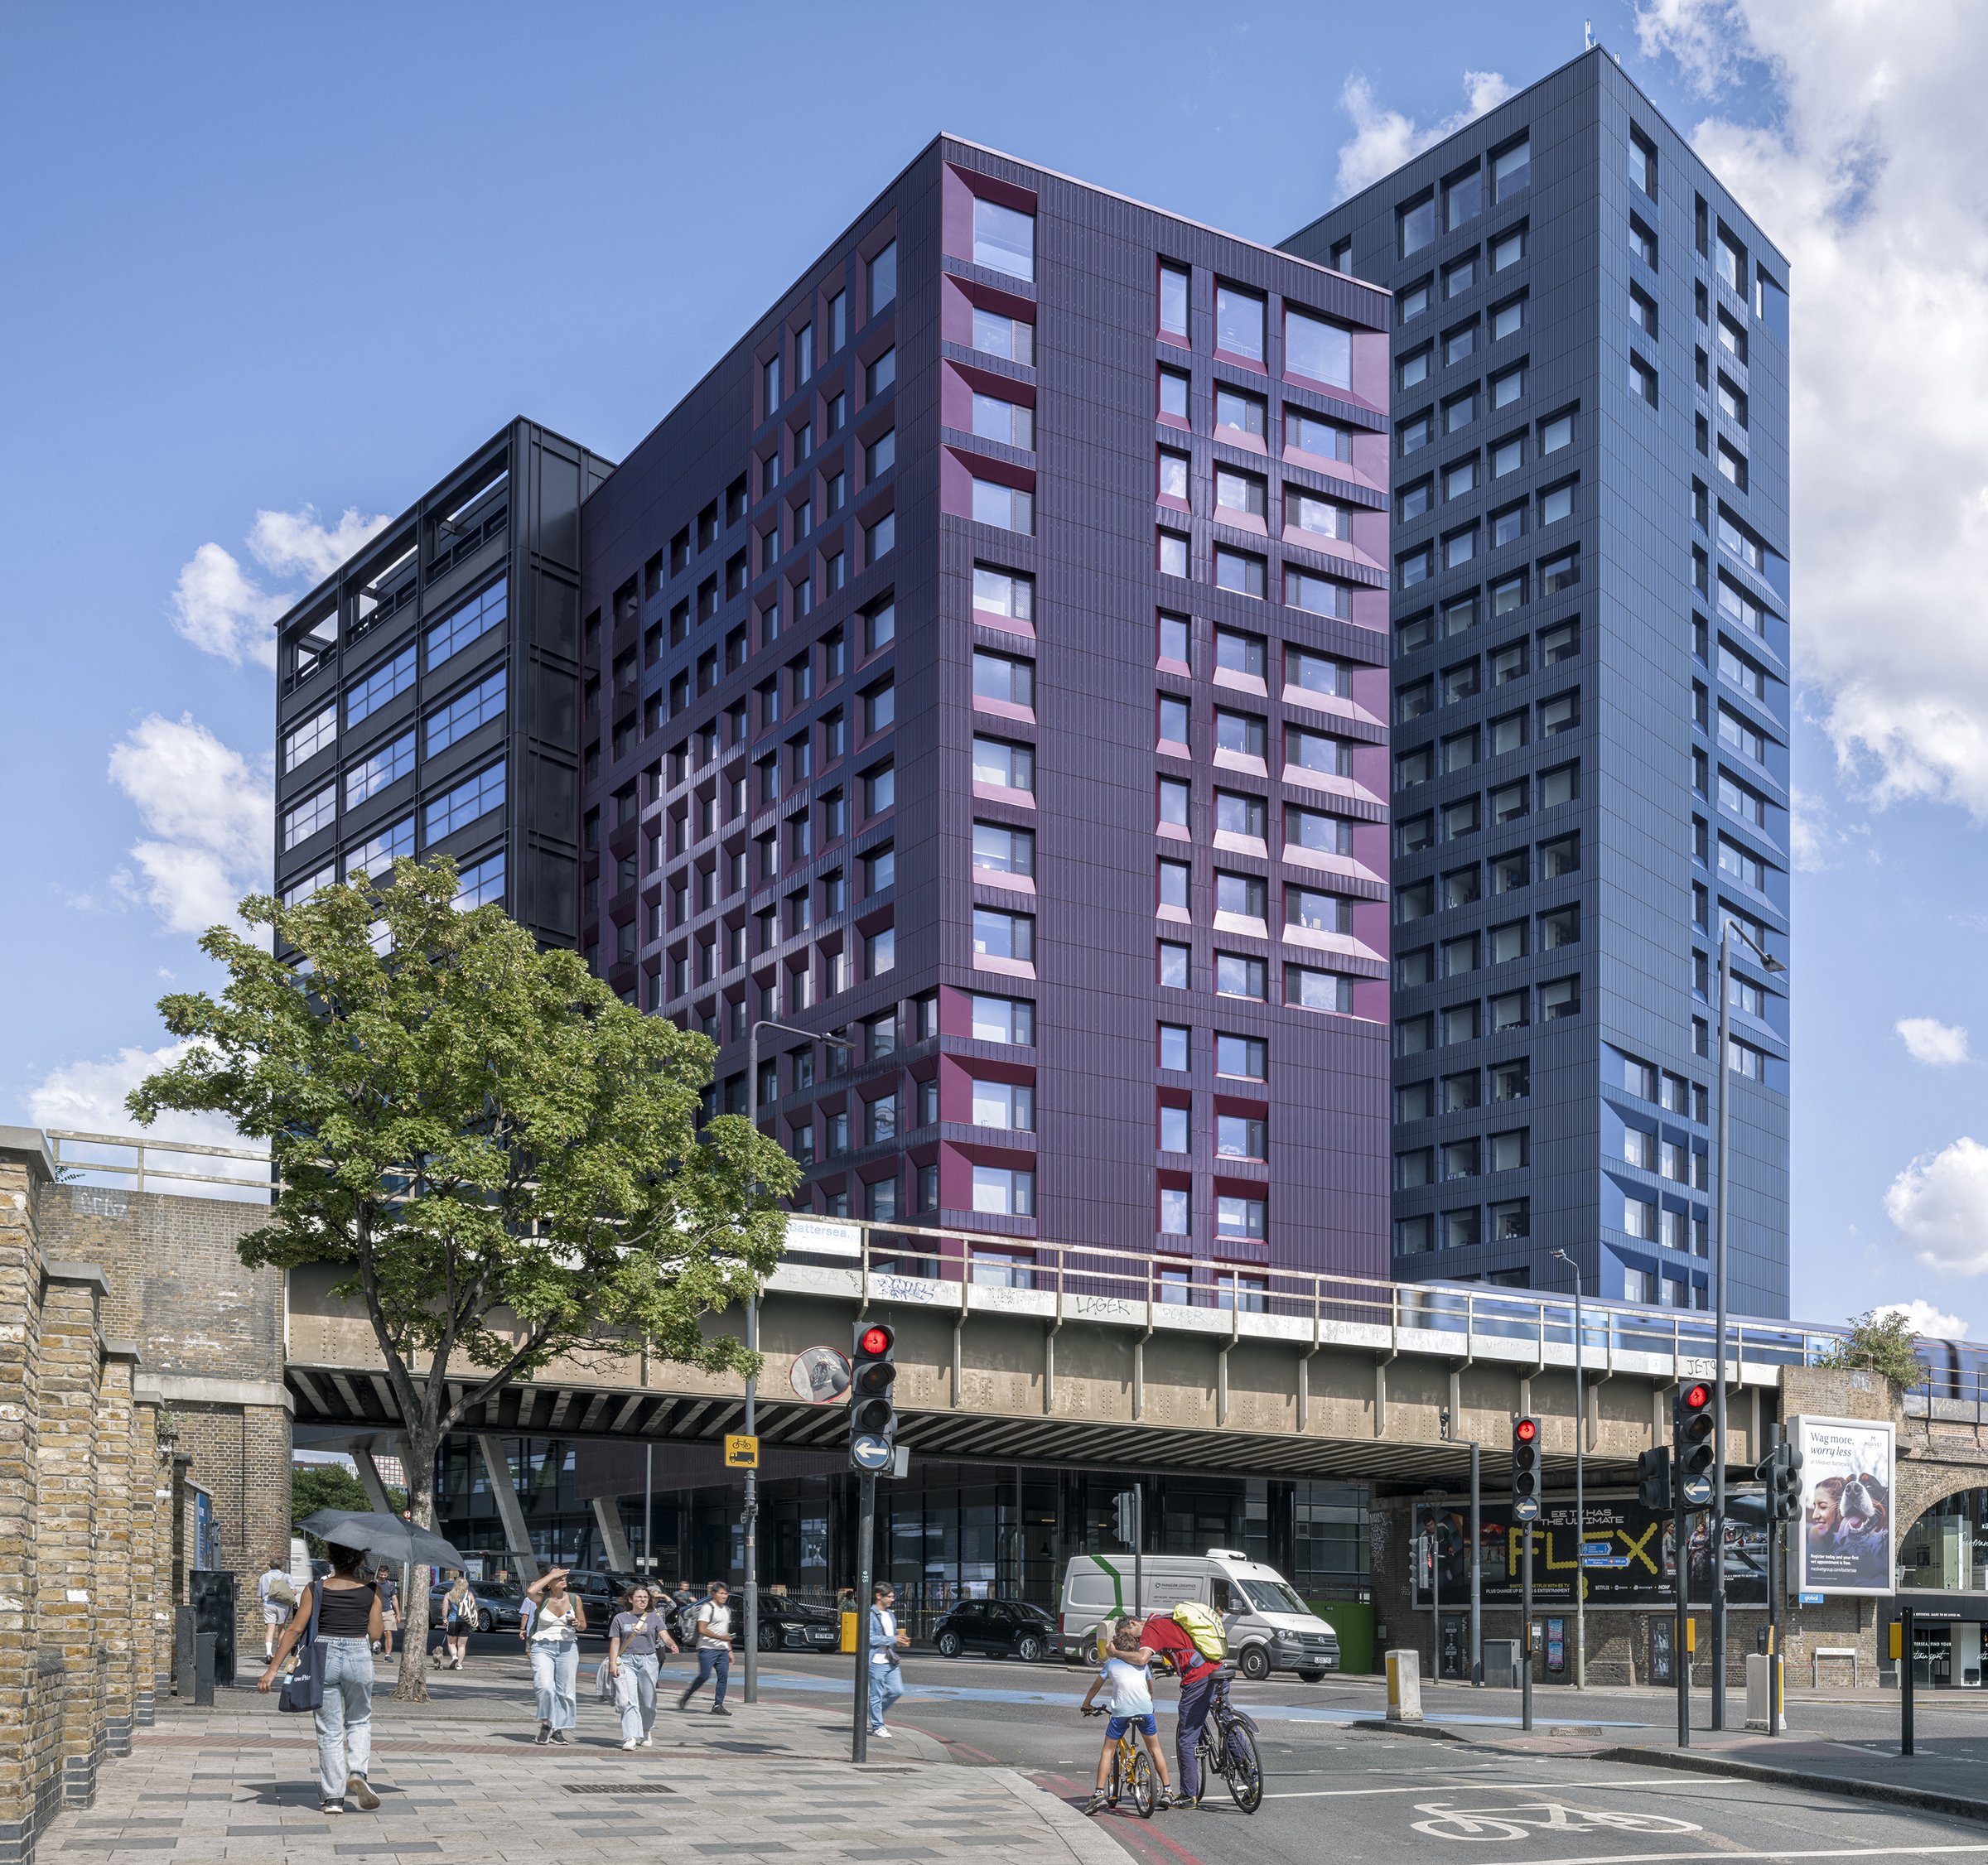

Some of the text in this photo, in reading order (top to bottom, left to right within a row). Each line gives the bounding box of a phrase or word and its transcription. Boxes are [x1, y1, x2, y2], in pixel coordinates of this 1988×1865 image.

[1811, 1432, 1855, 1445] Wag more,
[1811, 1446, 1852, 1458] worry less
